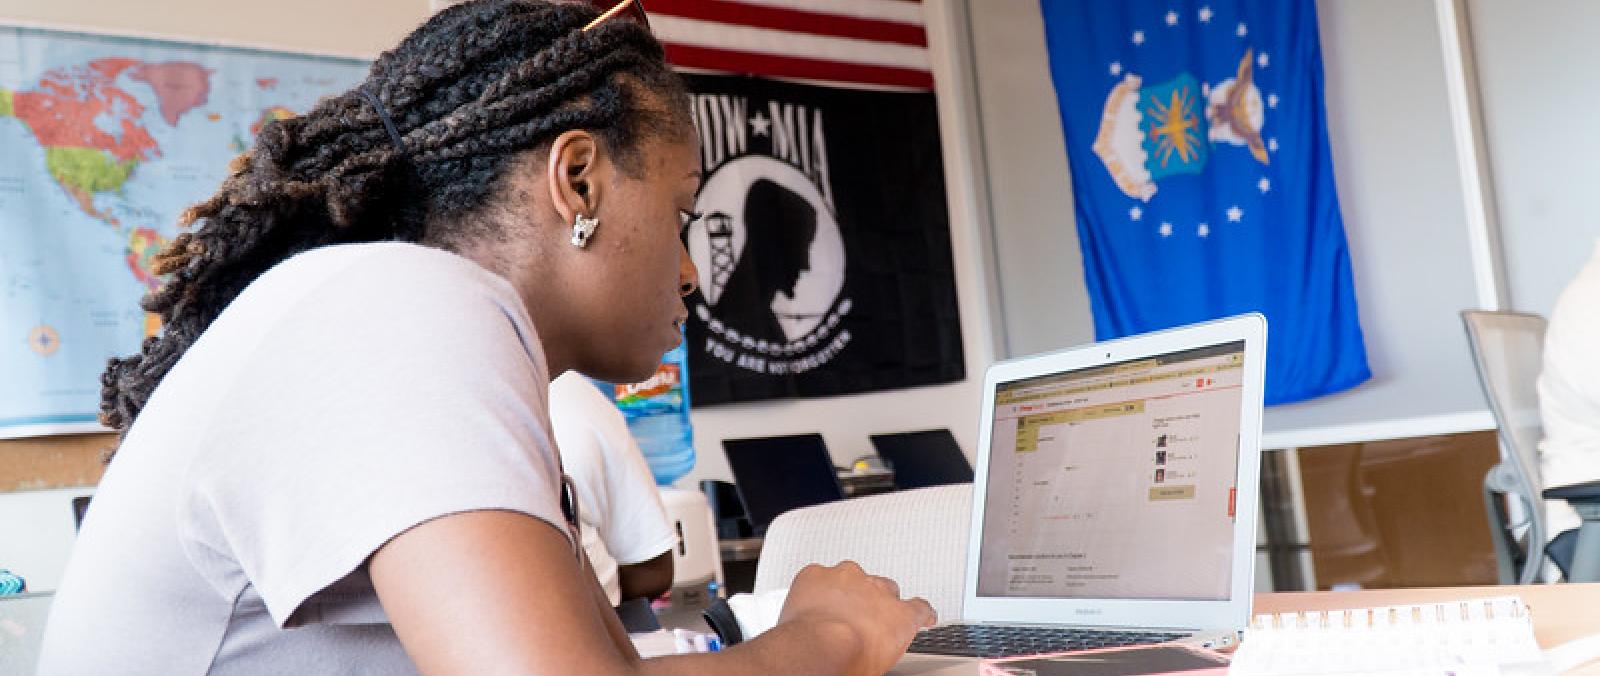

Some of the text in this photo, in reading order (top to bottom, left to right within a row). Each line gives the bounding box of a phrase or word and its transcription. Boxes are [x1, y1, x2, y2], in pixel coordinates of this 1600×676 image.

[768, 101, 835, 209] MIA
[706, 337, 734, 362] YOU
[737, 354, 765, 373] ARE
